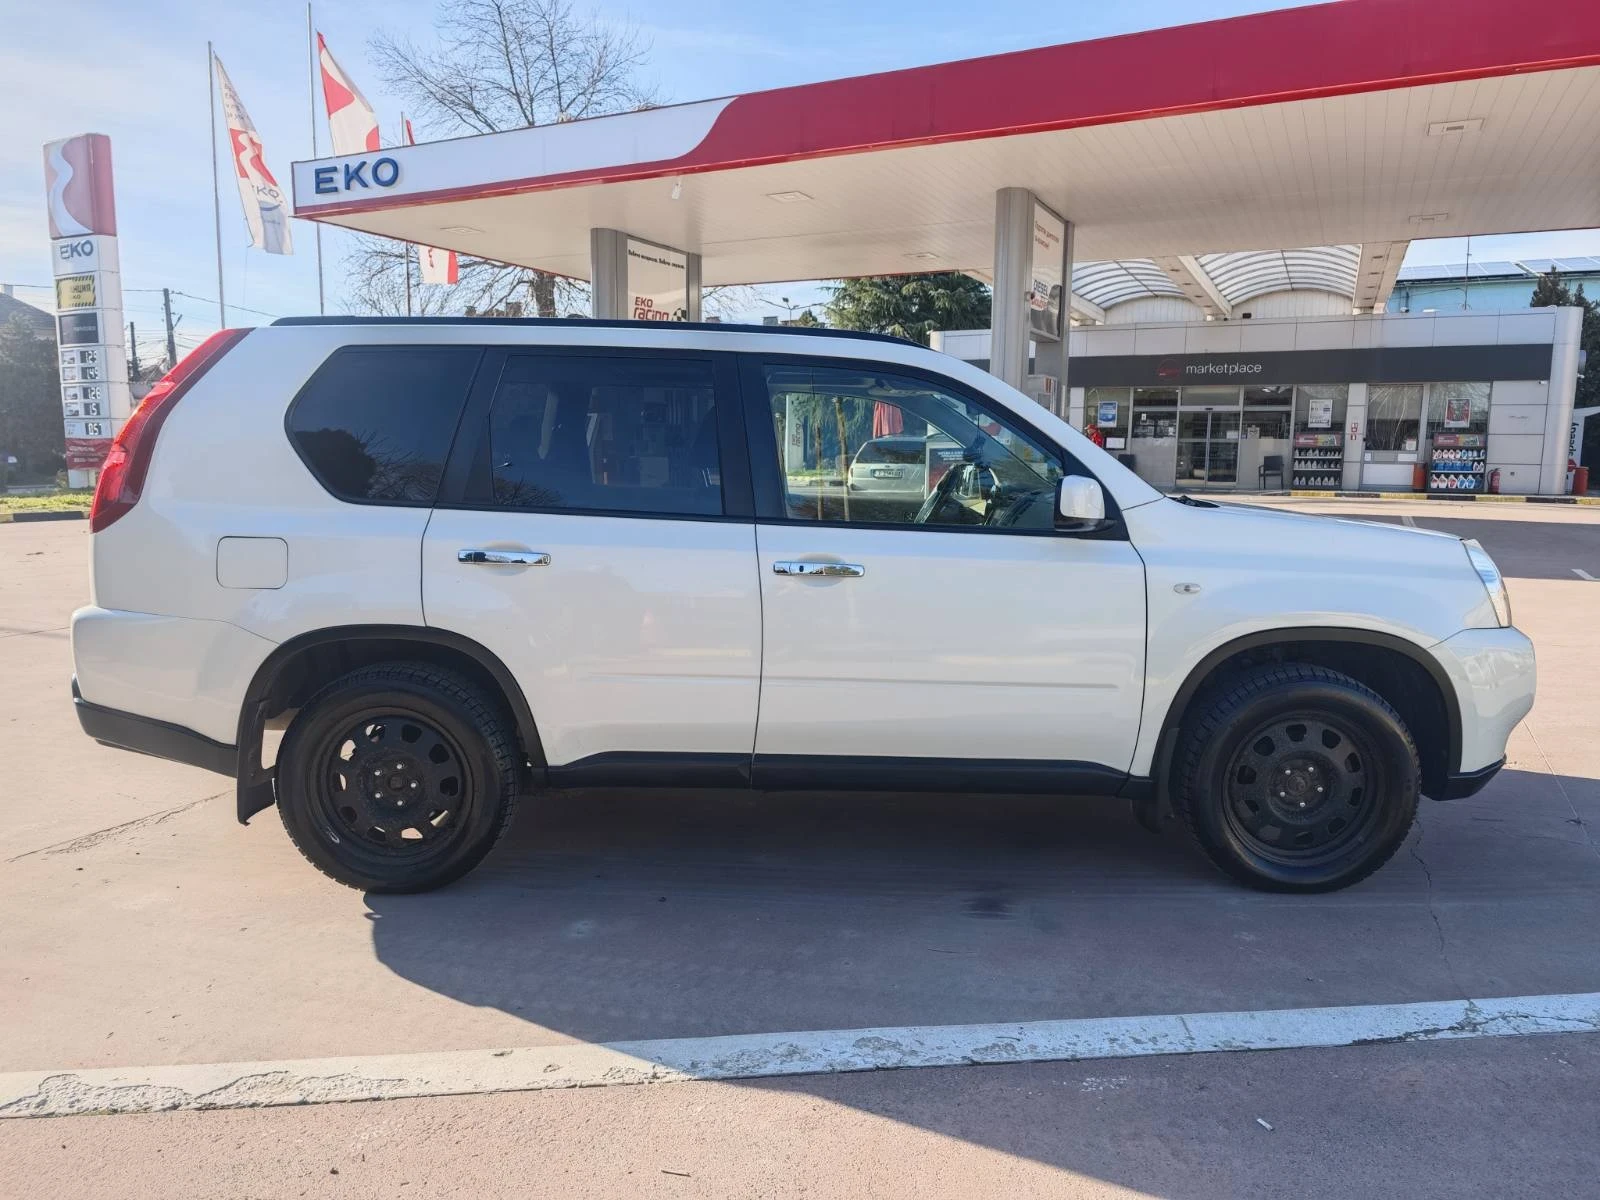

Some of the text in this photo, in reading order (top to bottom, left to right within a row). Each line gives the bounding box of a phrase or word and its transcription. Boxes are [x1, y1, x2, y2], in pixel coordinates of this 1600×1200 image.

[314, 157, 399, 194] EKO
[252, 184, 280, 199] KO
[60, 240, 94, 260] EKO
[635, 296, 653, 308] EKO
[1186, 362, 1262, 375] marketplace
